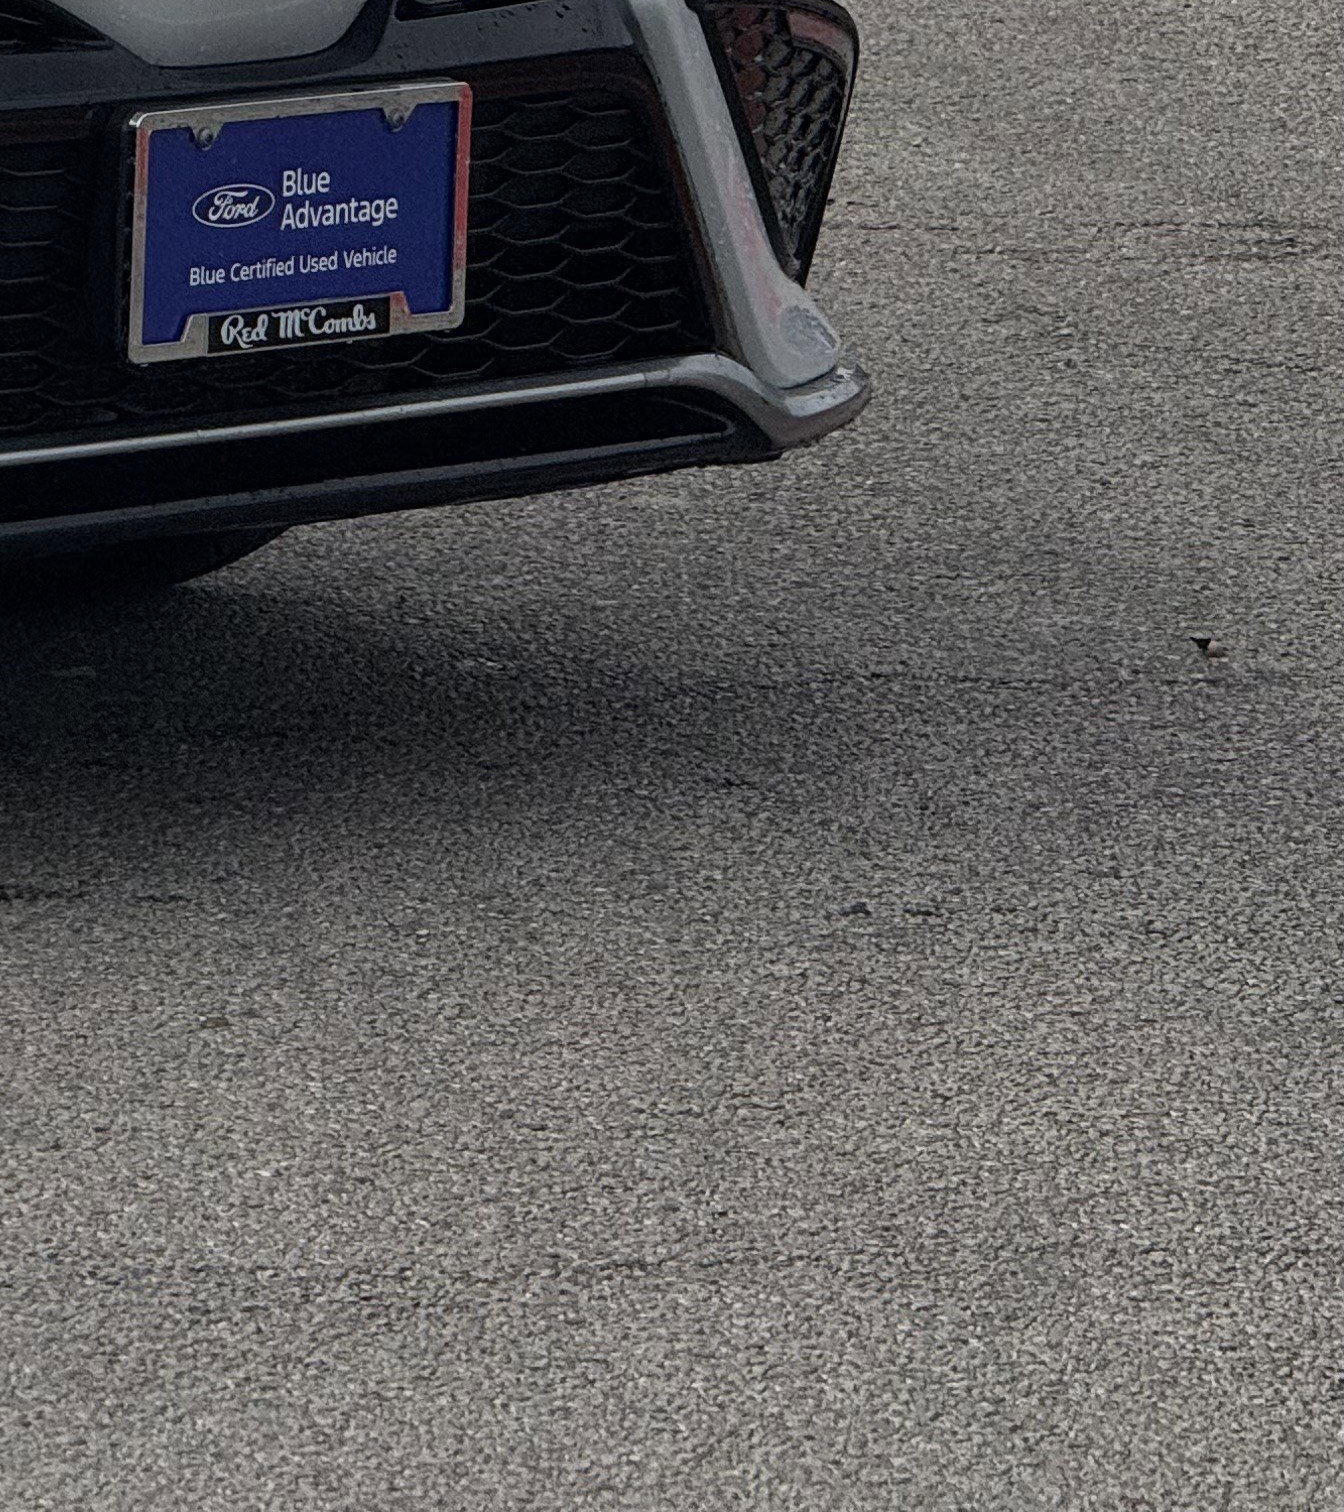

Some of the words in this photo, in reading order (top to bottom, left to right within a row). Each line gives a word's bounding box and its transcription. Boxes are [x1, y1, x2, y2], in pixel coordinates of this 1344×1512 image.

[282, 168, 331, 198] Blue
[208, 190, 260, 222] Ford
[279, 197, 399, 231] Advantage
[189, 265, 226, 287] Blue
[230, 255, 295, 282] Certified
[299, 250, 338, 273] Used
[343, 244, 398, 269] Vehicle
[220, 314, 269, 349] Red
[271, 303, 377, 339] McCombs
